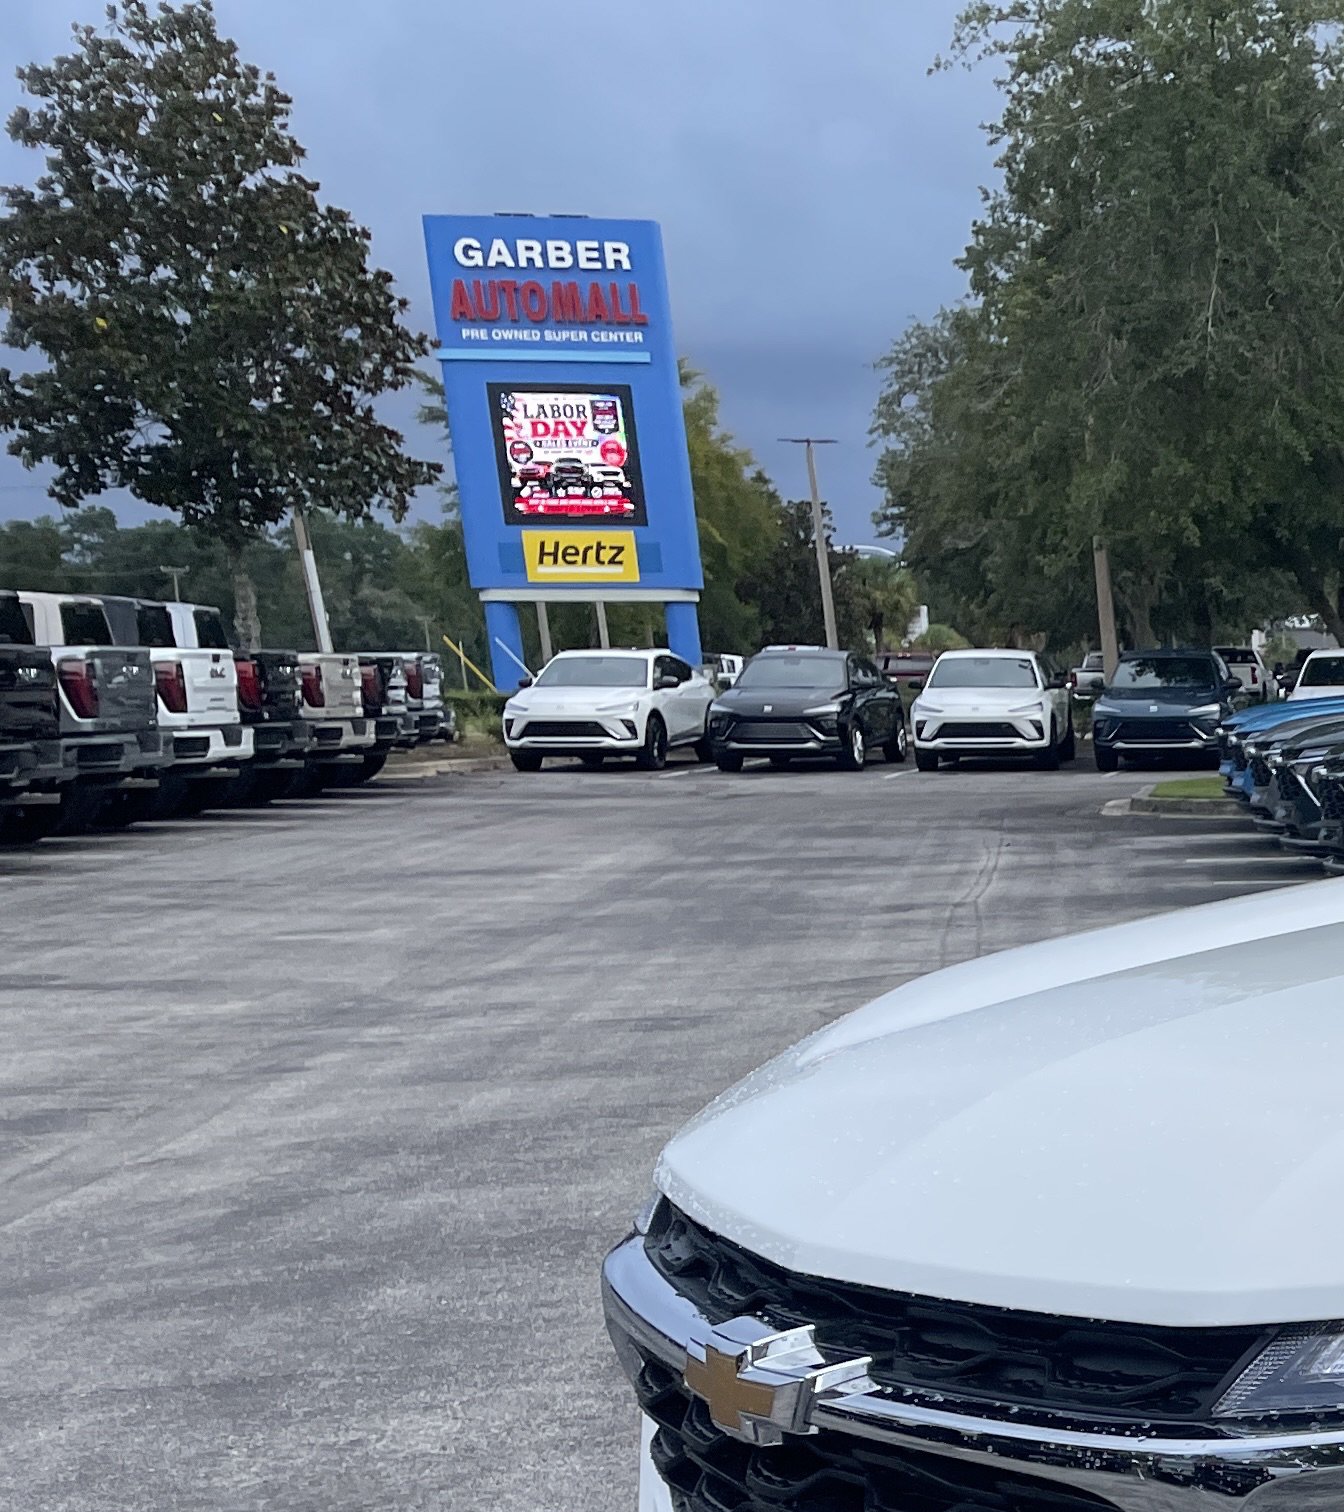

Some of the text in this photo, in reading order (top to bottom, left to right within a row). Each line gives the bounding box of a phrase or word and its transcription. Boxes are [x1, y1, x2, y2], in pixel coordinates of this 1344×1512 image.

[454, 237, 631, 270] GARBER
[451, 279, 648, 324] AUTOMALL
[461, 328, 643, 343] PRE OWNED SUPER CENTER
[523, 404, 588, 419] LABOR
[530, 420, 588, 438] DAY
[538, 540, 625, 566] Hertz
